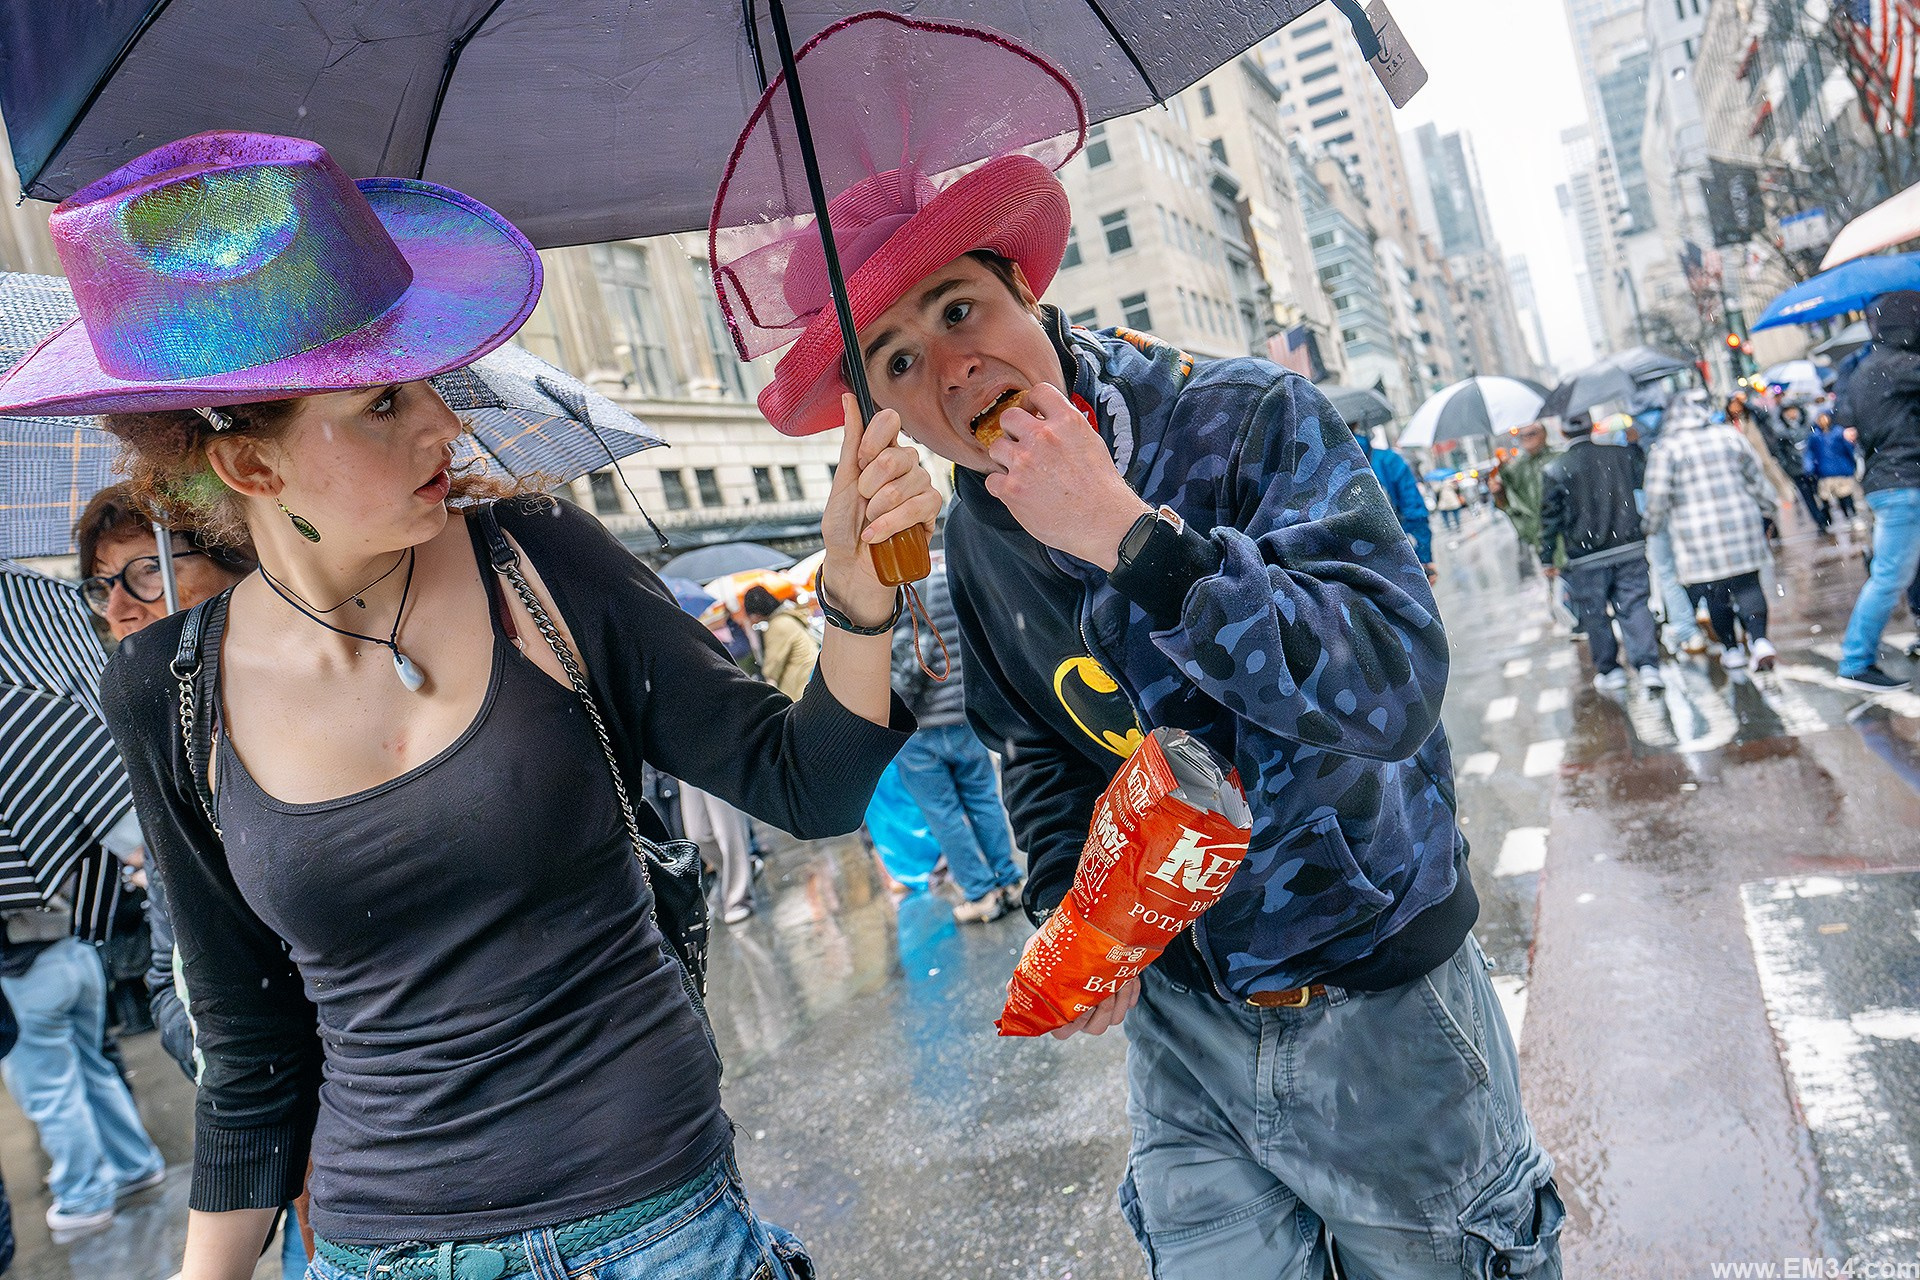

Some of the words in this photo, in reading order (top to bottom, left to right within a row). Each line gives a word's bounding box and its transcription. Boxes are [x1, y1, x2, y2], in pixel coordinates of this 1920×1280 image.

[1386, 65, 1392, 73] T
[1397, 52, 1403, 60] T
[1114, 965, 1141, 978] BA
